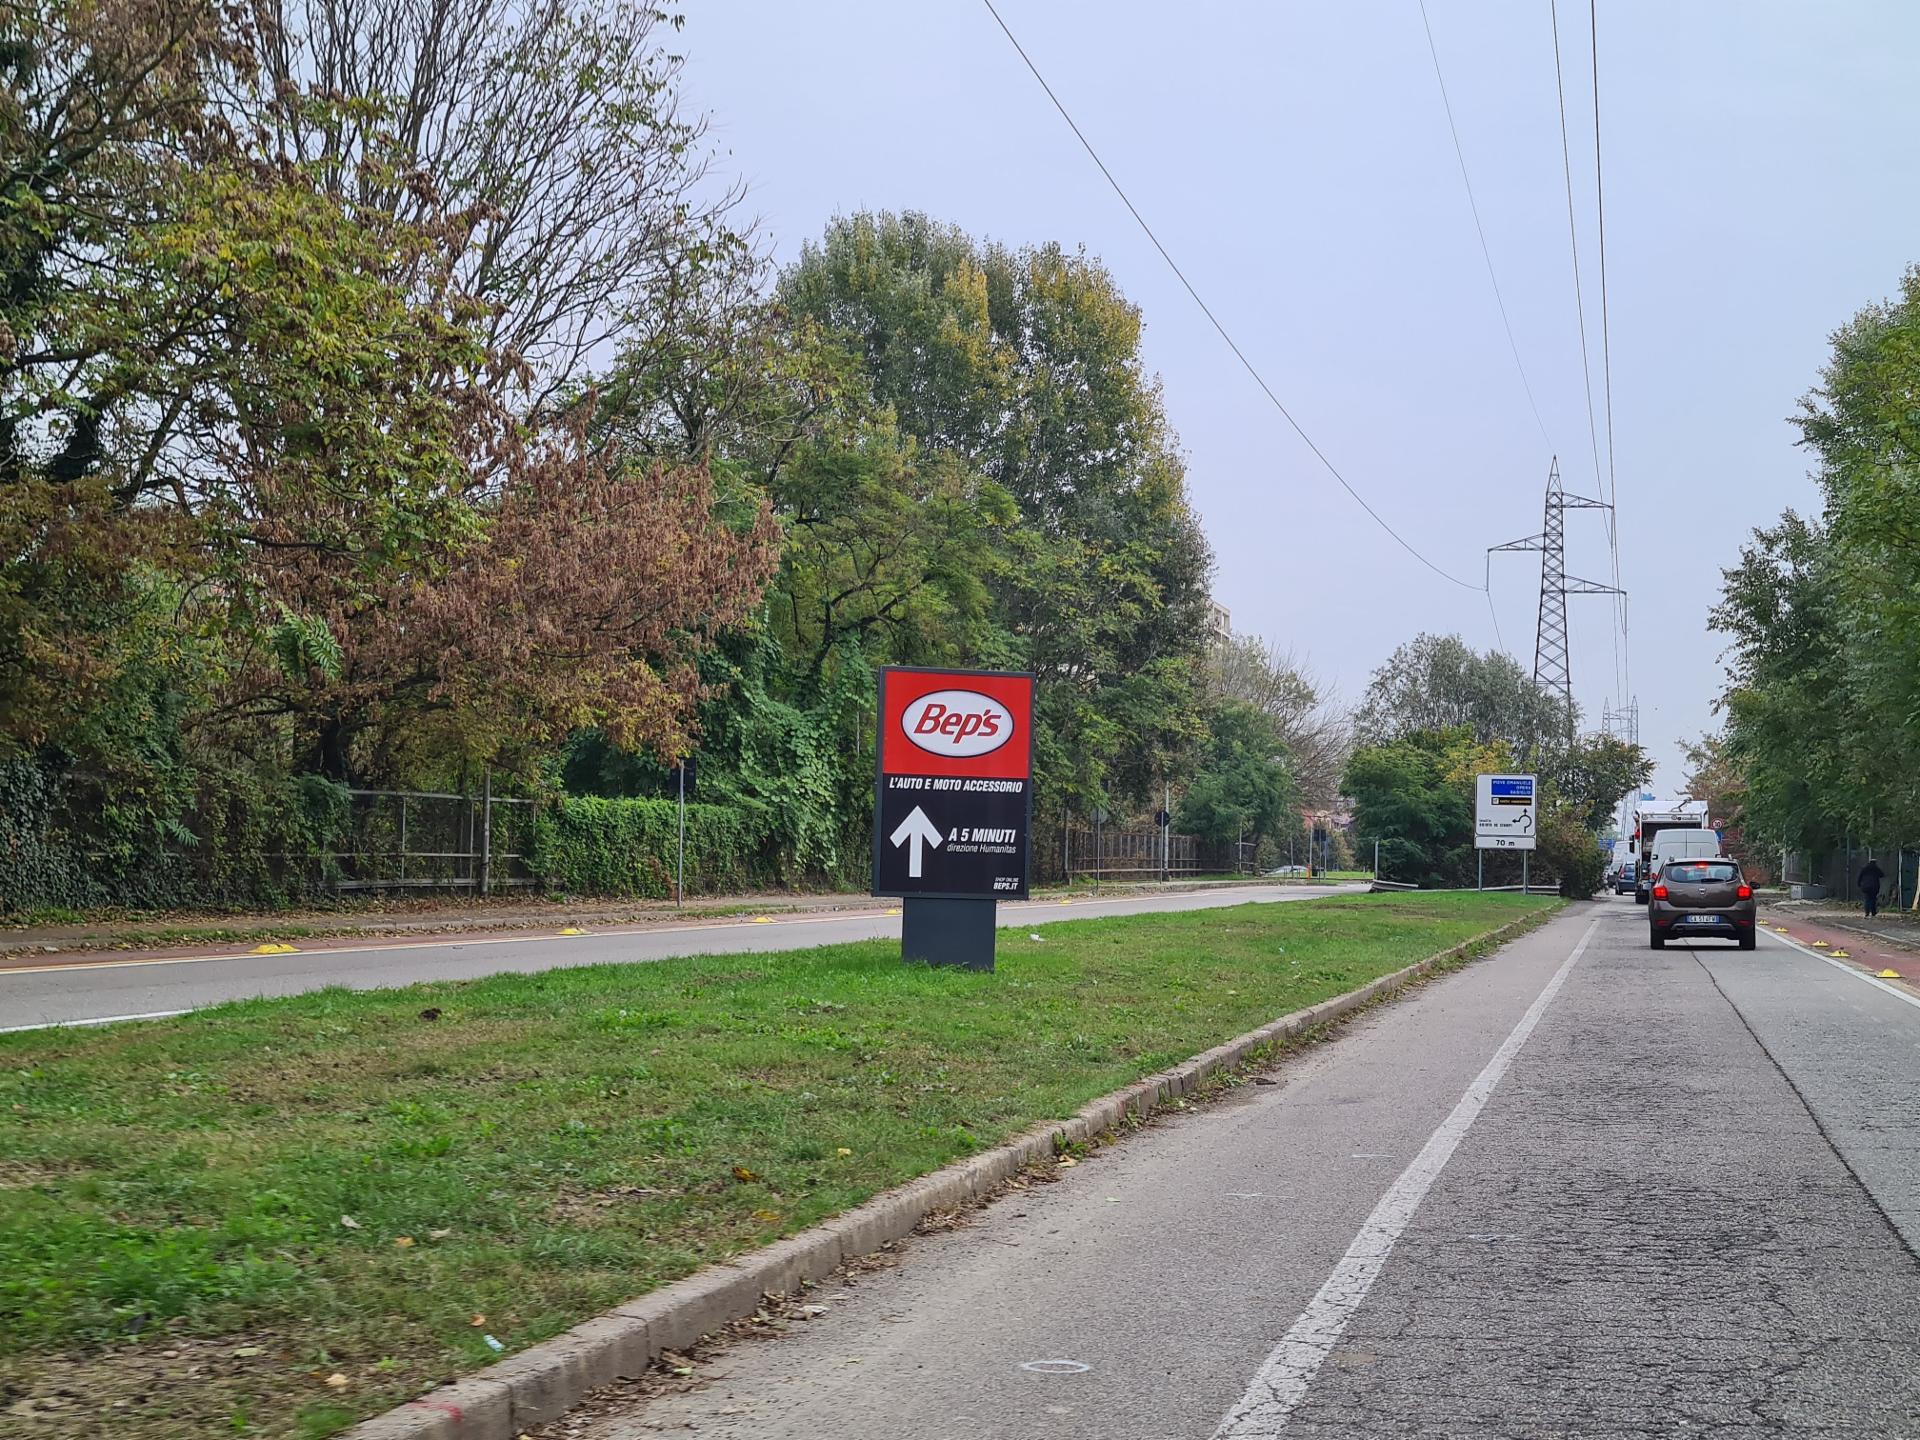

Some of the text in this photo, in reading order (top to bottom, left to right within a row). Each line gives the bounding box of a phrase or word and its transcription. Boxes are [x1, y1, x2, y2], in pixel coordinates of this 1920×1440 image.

[914, 704, 1001, 744] Bep's
[889, 777, 1023, 793] L'AUTO E MOTO ACCESSORIO
[948, 828, 1016, 844] A 5 MINUTI
[947, 843, 1016, 854] direzione Humanitas
[993, 882, 1019, 890] BEPS.IT
